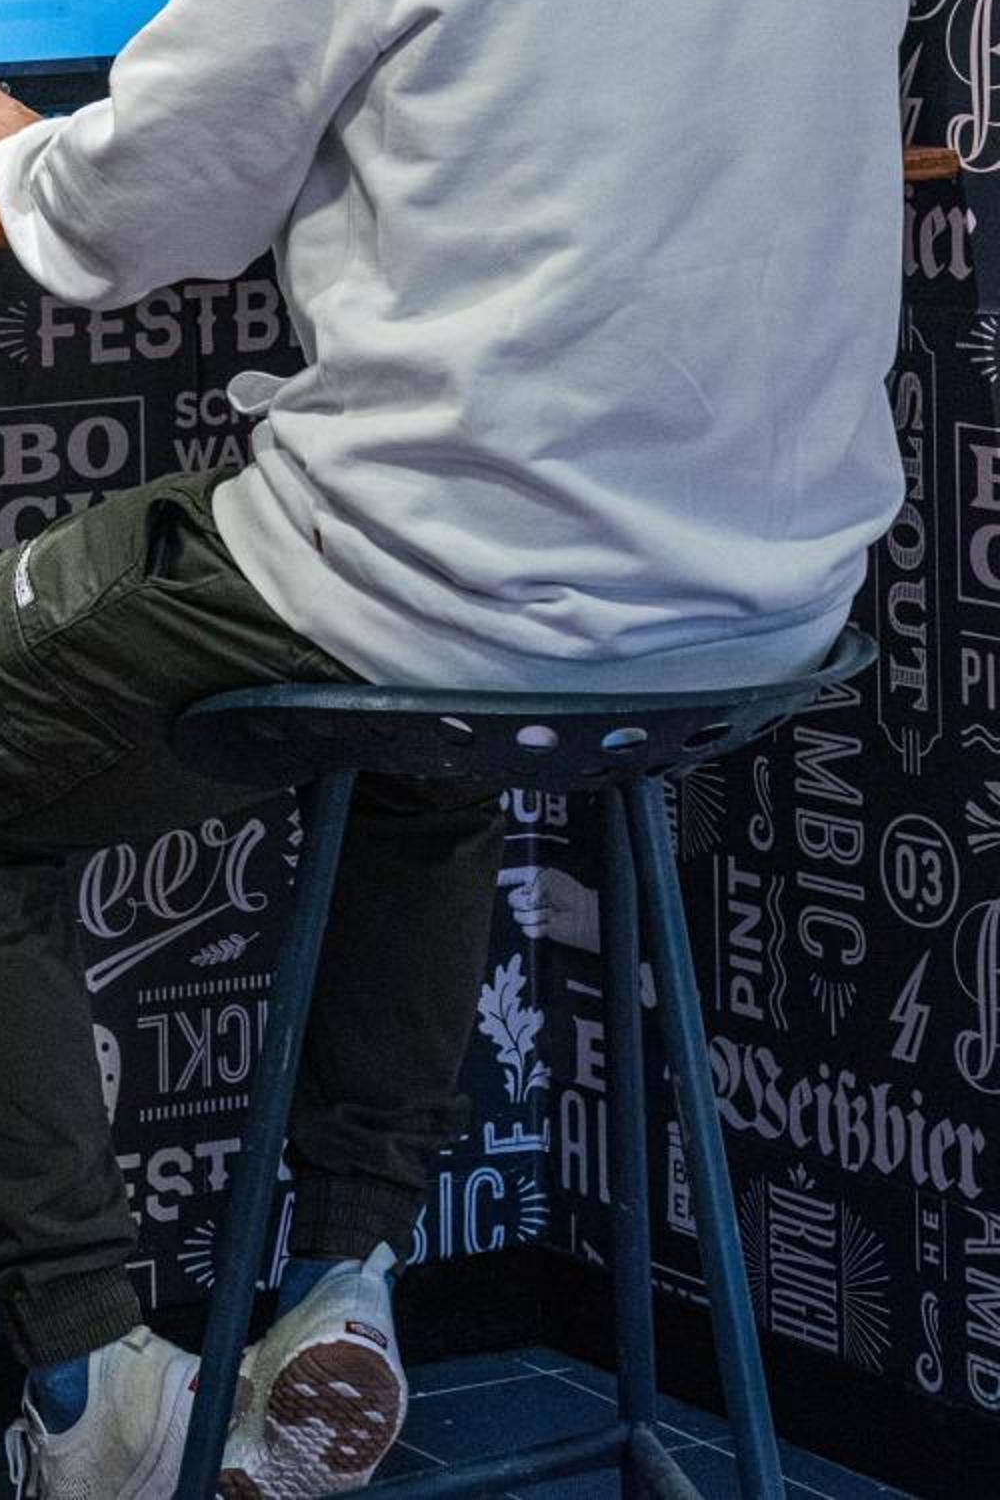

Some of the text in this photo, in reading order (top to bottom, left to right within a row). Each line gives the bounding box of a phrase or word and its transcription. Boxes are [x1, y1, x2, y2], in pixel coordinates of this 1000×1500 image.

[79, 818, 269, 938] eer
[727, 855, 764, 1021] PINT
[767, 1178, 839, 1354] DRAUGH
